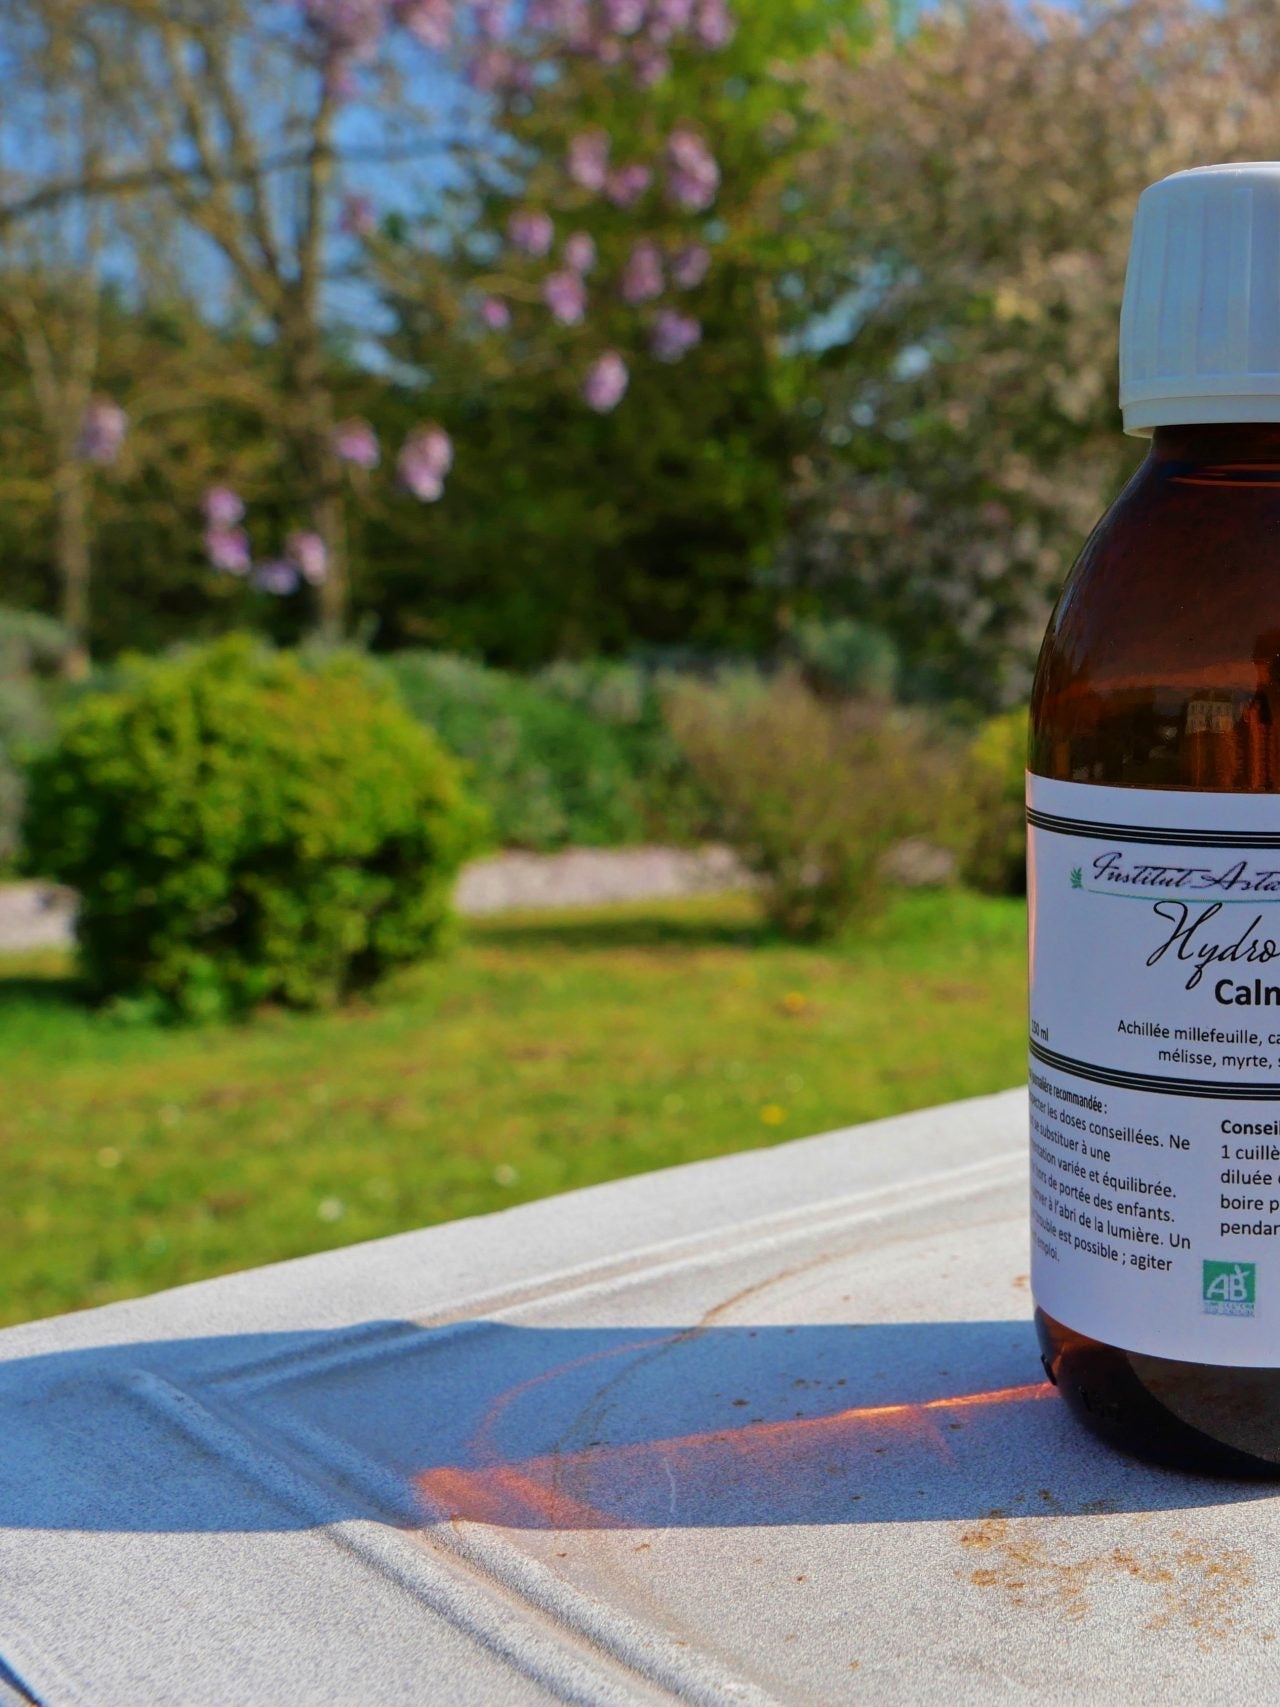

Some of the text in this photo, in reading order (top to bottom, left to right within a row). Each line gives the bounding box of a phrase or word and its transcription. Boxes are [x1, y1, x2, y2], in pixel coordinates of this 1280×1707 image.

[1093, 852, 1211, 887] Institut
[1041, 1027, 1049, 1041] ml
[1117, 1019, 1170, 1039] Achillée
[1174, 1027, 1263, 1046] millefeuille,
[1158, 1049, 1217, 1068] mélisse,
[1221, 1053, 1273, 1070] myrte,
[1053, 1084, 1103, 1114] recommandée
[1047, 1102, 1058, 1121] les
[1059, 1108, 1087, 1131] doses
[1089, 1121, 1164, 1148] conseillées.
[1169, 1133, 1191, 1151] Ne
[1040, 1123, 1079, 1151] substituer
[1081, 1139, 1087, 1155] à
[1090, 1146, 1111, 1162] une
[1221, 1144, 1231, 1160] 1
[1057, 1157, 1086, 1179] variée
[1088, 1169, 1100, 1184] et
[1102, 1171, 1177, 1199] équilibrée.
[1220, 1168, 1273, 1185] diluée
[1048, 1175, 1058, 1191] de
[1059, 1181, 1091, 1204] portée
[1093, 1193, 1113, 1212] des
[1116, 1201, 1175, 1223] enfants.
[1220, 1193, 1264, 1211] boire
[1078, 1211, 1091, 1229] de
[1094, 1215, 1104, 1233] la
[1107, 1219, 1164, 1246] lumière.
[1169, 1232, 1191, 1250] Un
[1058, 1228, 1072, 1245] est
[1074, 1235, 1118, 1262] possible
[1129, 1253, 1173, 1272] agiter
[1206, 1272, 1249, 1301] AB
